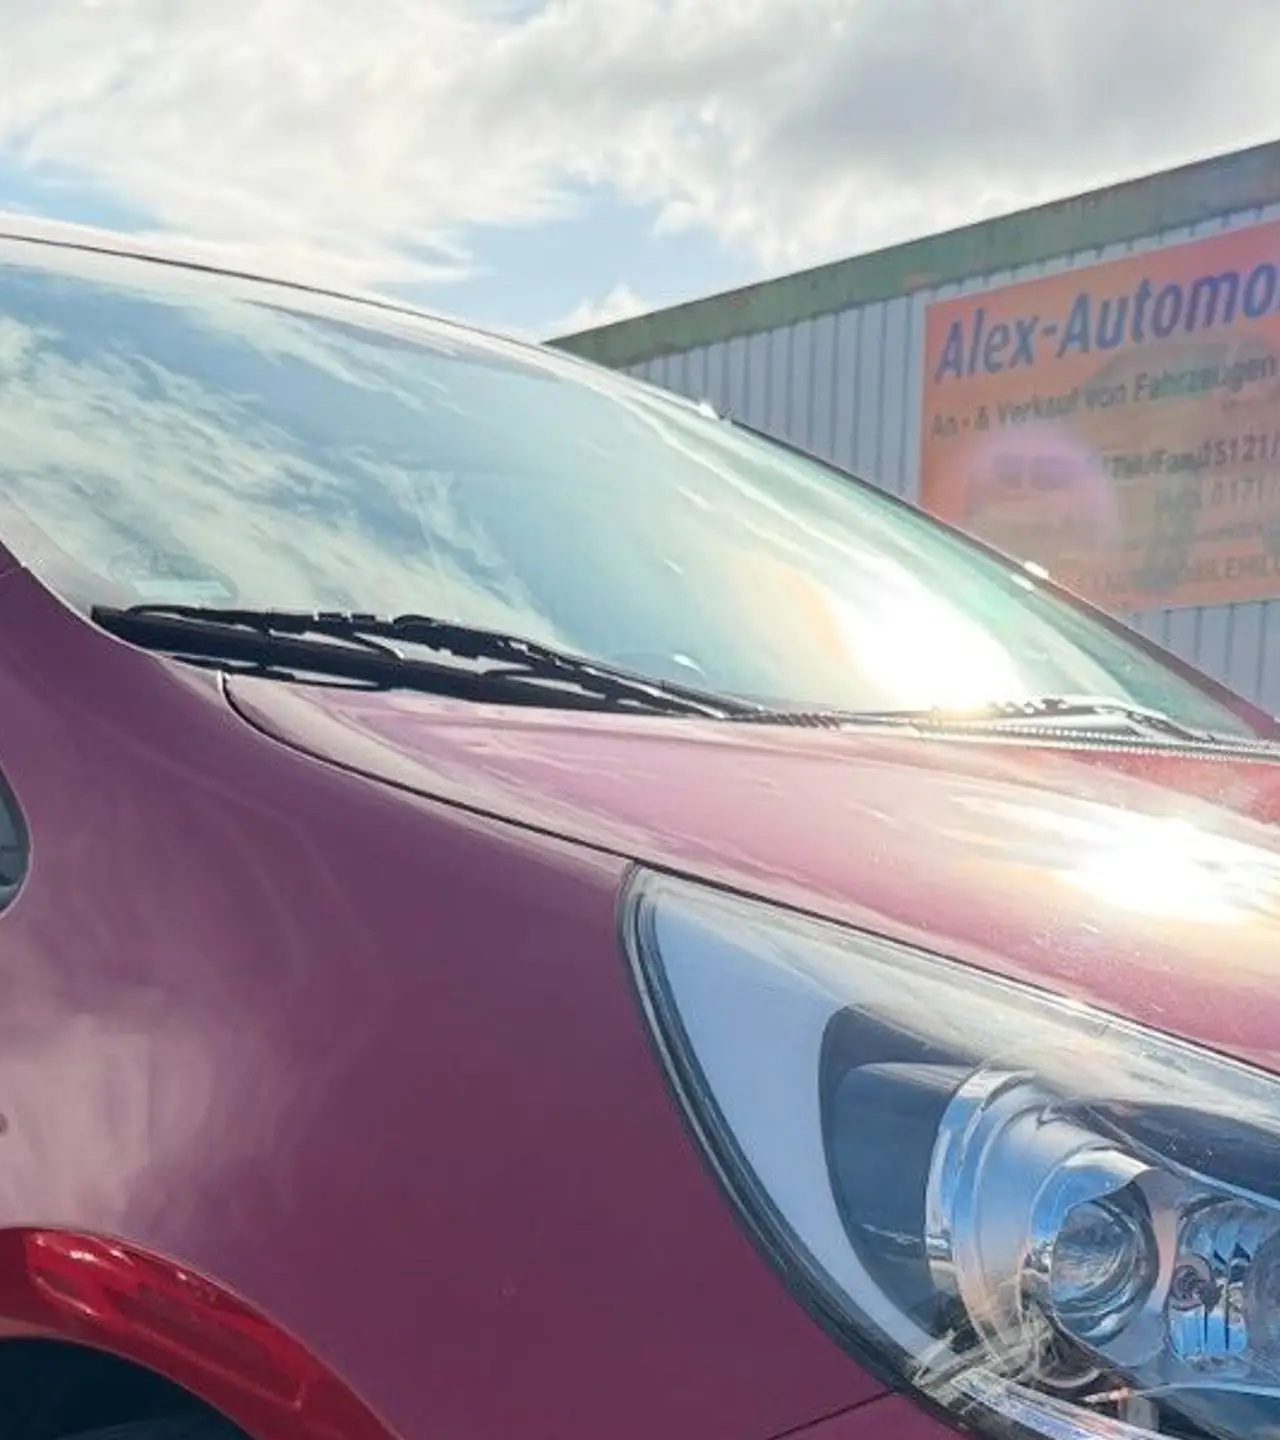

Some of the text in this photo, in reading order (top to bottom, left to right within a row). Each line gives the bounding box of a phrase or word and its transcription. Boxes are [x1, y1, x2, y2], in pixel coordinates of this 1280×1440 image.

[997, 387, 1080, 425] Verkauf
[1086, 380, 1127, 411] von
[1133, 354, 1278, 404] Fahrzeugen
